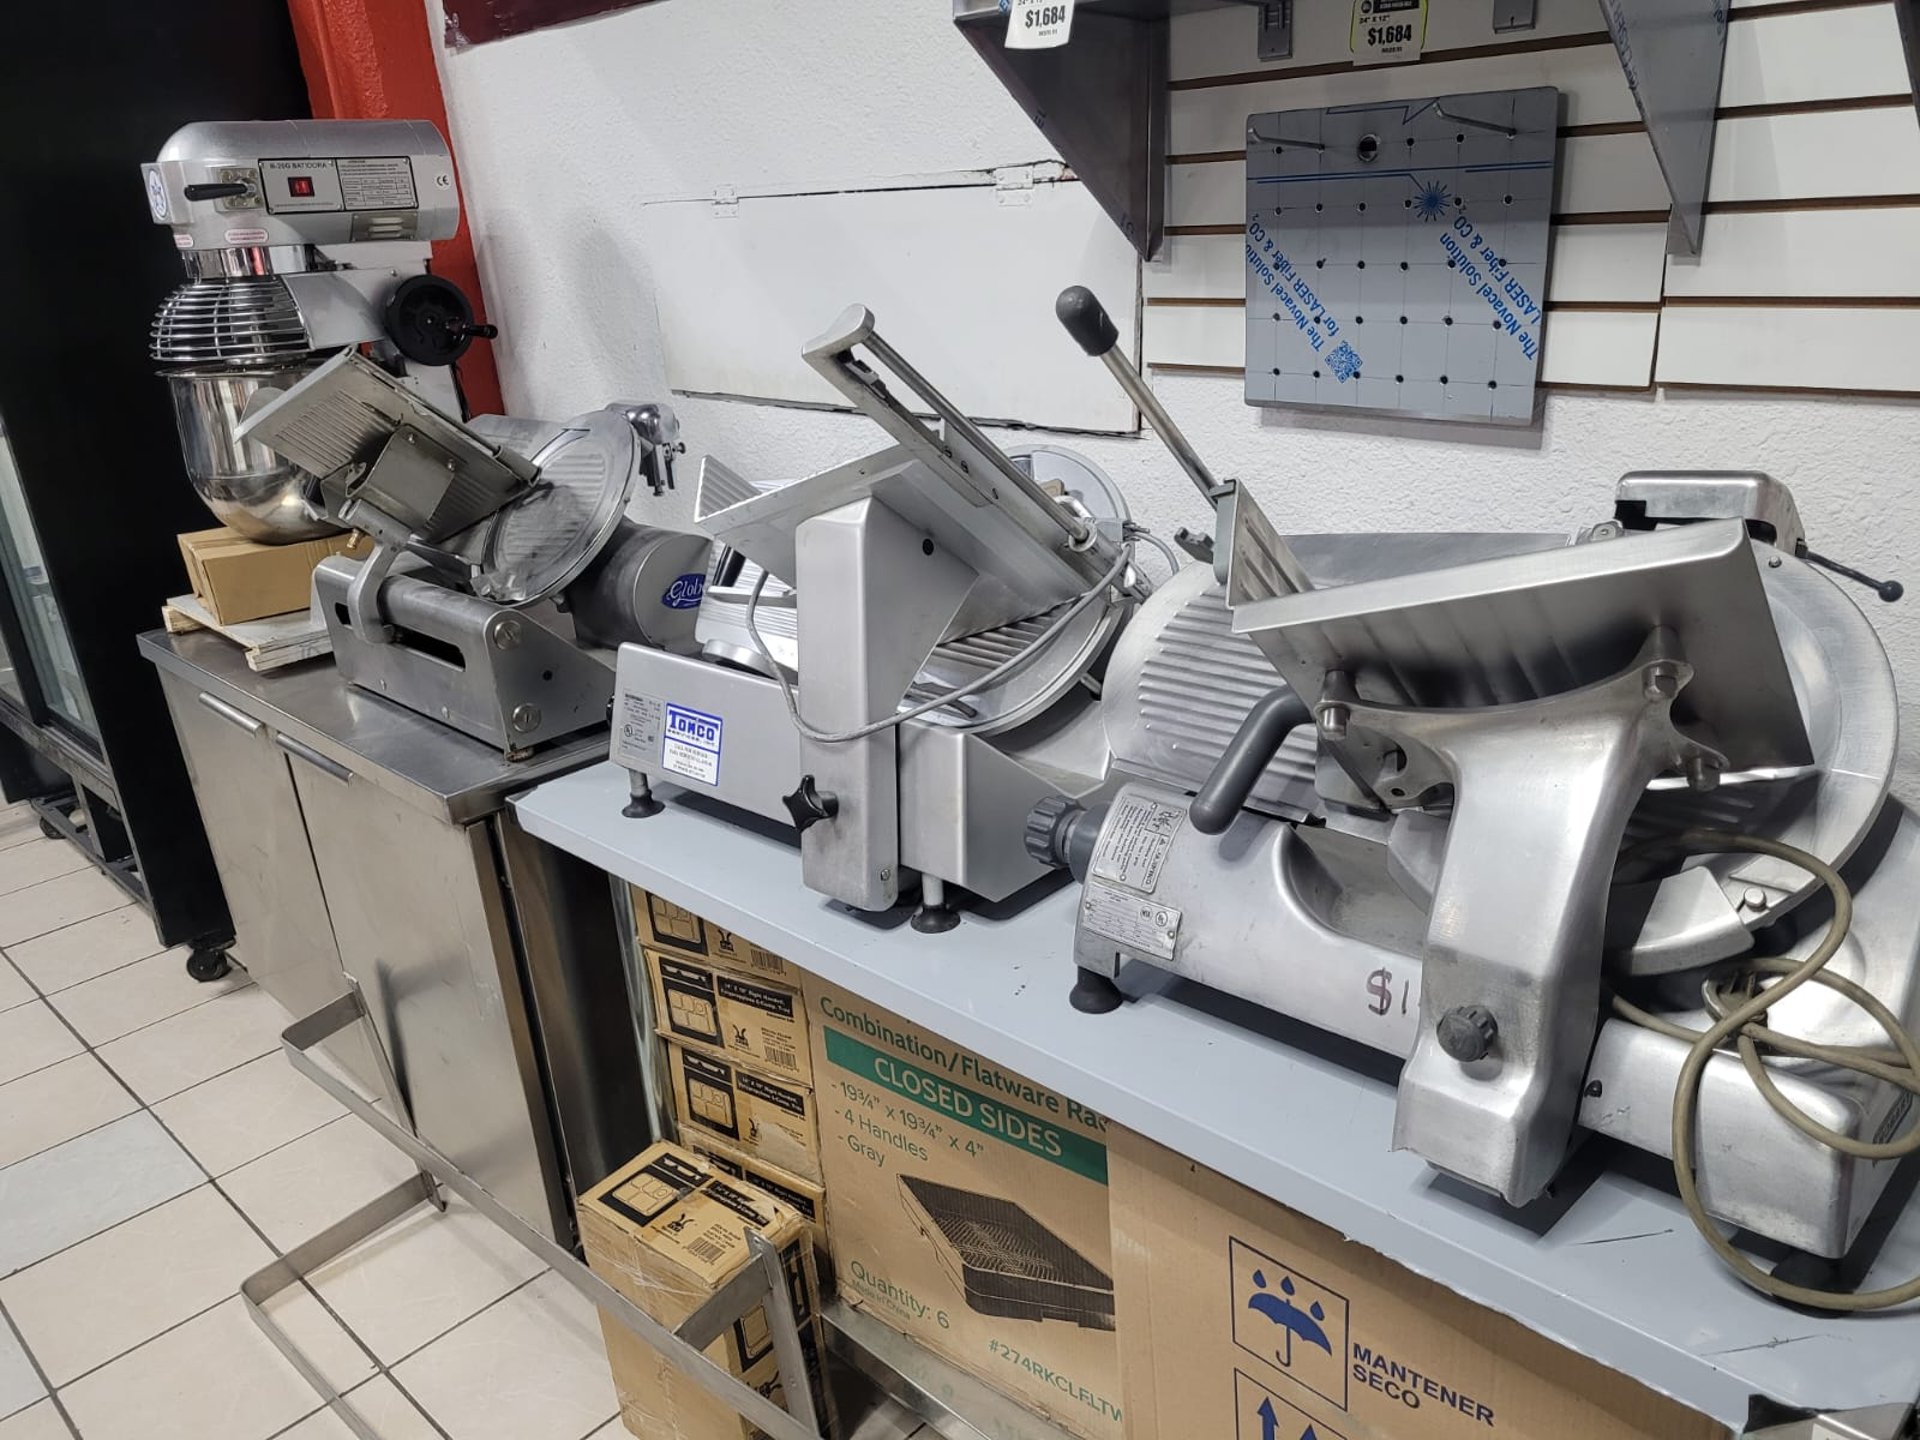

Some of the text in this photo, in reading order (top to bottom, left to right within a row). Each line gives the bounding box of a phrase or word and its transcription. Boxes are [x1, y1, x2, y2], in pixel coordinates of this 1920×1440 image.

[1025, 5, 1066, 28] $1,684
[1368, 24, 1412, 46] $1,684
[1263, 239, 1274, 251] &
[1470, 233, 1483, 249] &
[1271, 250, 1297, 282] Fiber
[1480, 247, 1510, 282] Fiber
[1246, 244, 1324, 352] The Novacel Solutio
[1292, 278, 1326, 318] LASER
[1439, 232, 1538, 361] The Novacel Solution
[1504, 277, 1541, 325] LASER
[1322, 316, 1340, 337] for
[666, 578, 703, 607] Glob
[669, 710, 719, 741] TOMCO
[820, 996, 1059, 1113] Combination/Flatware
[874, 1057, 1062, 1157] CLOSED SIDES
[844, 1108, 854, 1124] 4
[859, 1114, 928, 1162] Handles
[847, 1133, 885, 1168] Gray
[851, 1261, 949, 1329] Quantity: 6
[1353, 1342, 1494, 1427] MANTENER
[1353, 1363, 1420, 1409] SECO
